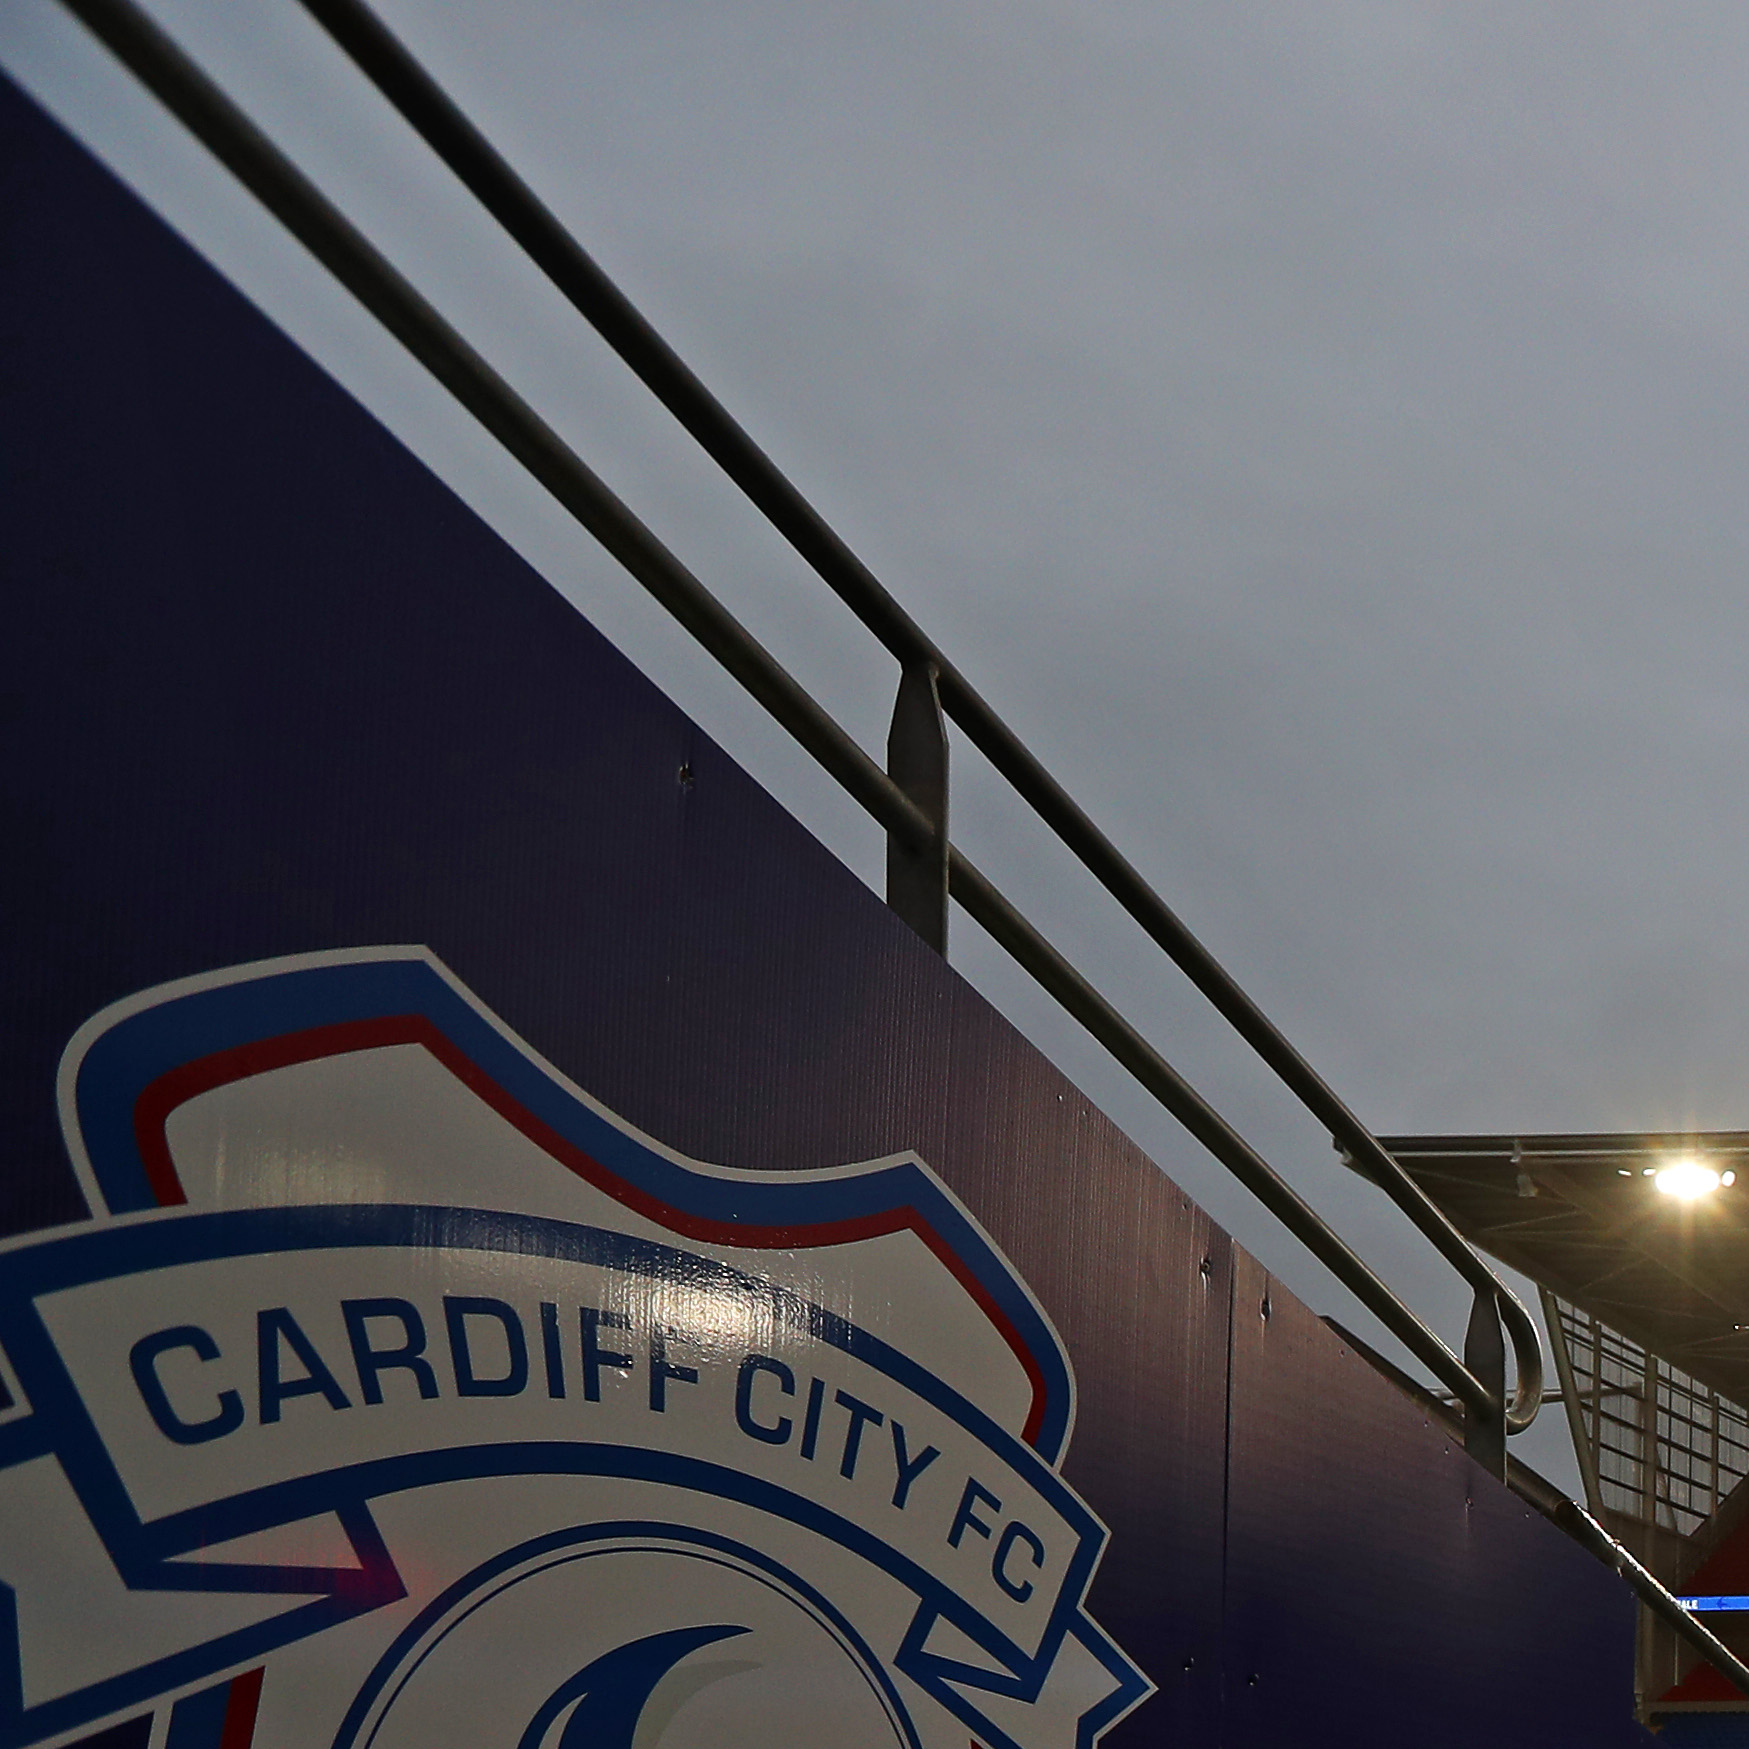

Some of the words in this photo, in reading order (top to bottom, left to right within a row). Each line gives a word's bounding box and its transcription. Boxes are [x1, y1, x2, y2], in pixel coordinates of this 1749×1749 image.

[128, 1296, 700, 1447] CARDIFF
[733, 1356, 940, 1510] CITY
[947, 1475, 1046, 1605] FC
